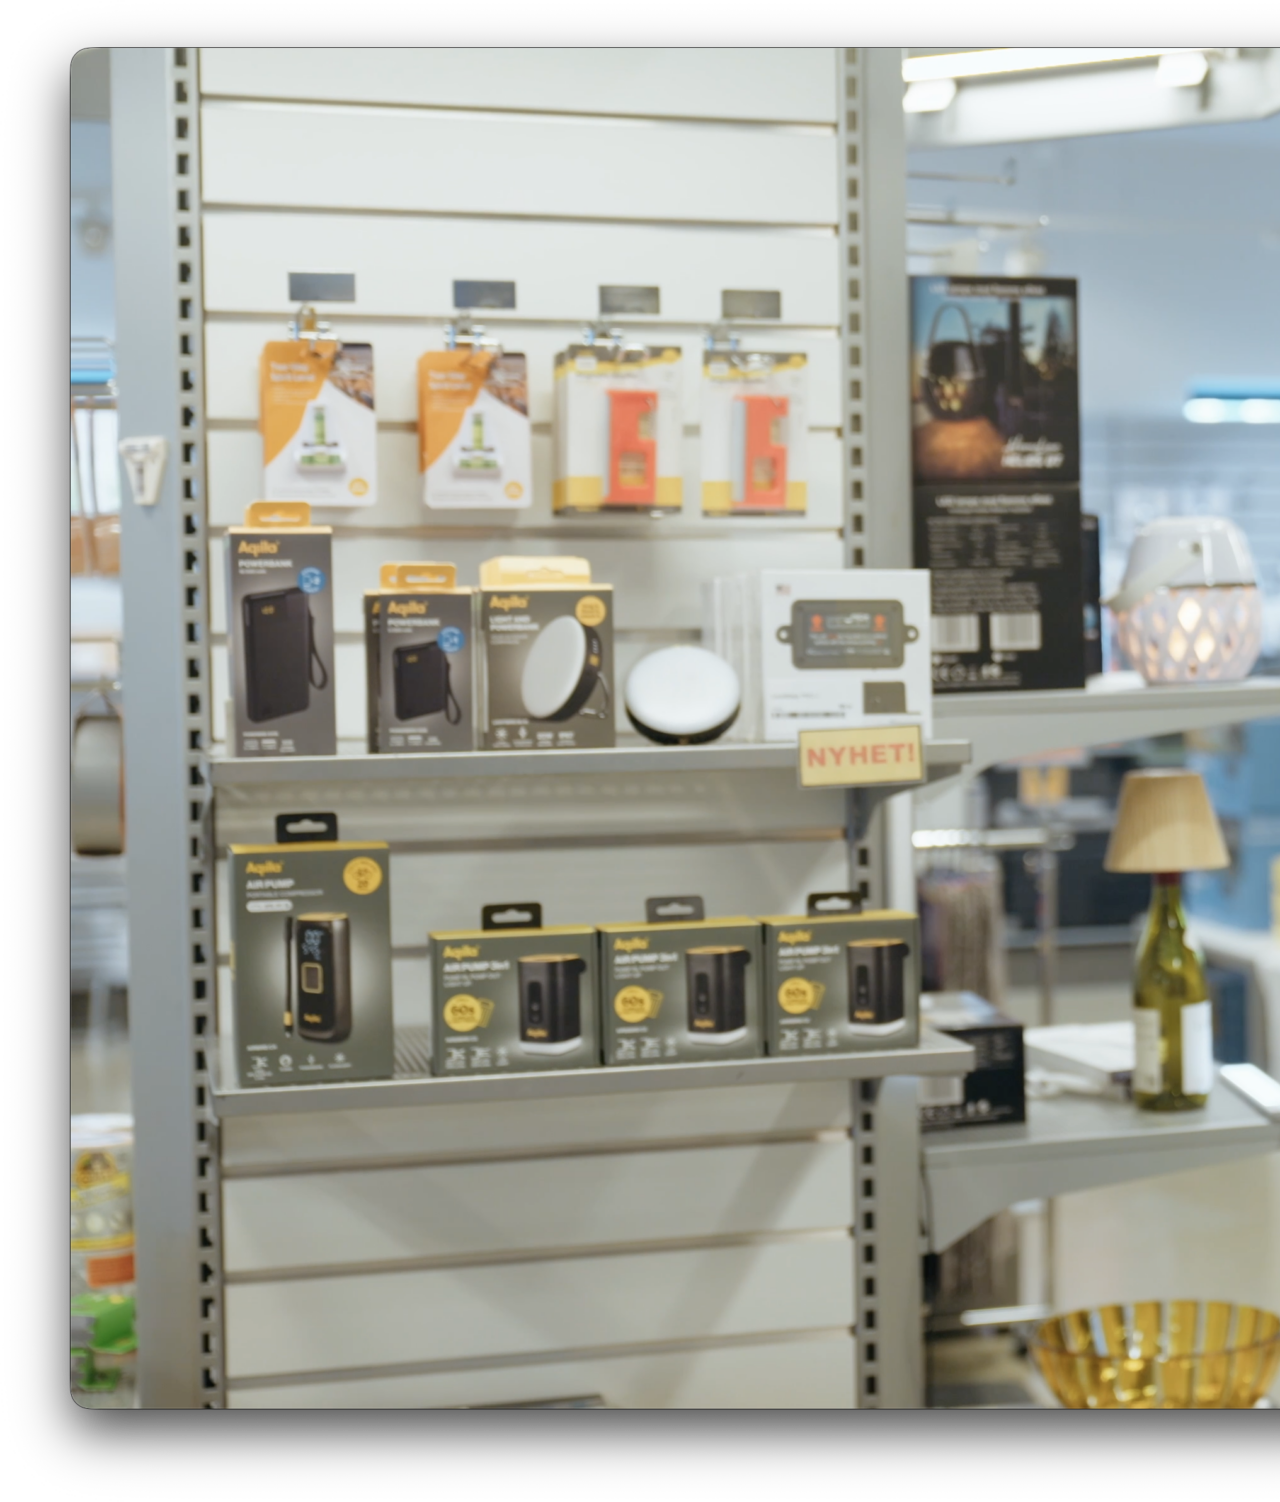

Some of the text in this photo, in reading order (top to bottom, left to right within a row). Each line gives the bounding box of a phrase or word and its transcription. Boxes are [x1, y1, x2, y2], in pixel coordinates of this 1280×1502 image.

[238, 559, 293, 568] POWERBANK
[387, 618, 440, 627] POWERBANK
[489, 615, 512, 625] LIGHT
[489, 623, 539, 632] POWERBANK
[806, 742, 916, 768] NYHET!
[246, 879, 295, 890] AIR PUMP
[443, 962, 460, 973] AIR
[461, 961, 490, 972] PUMP
